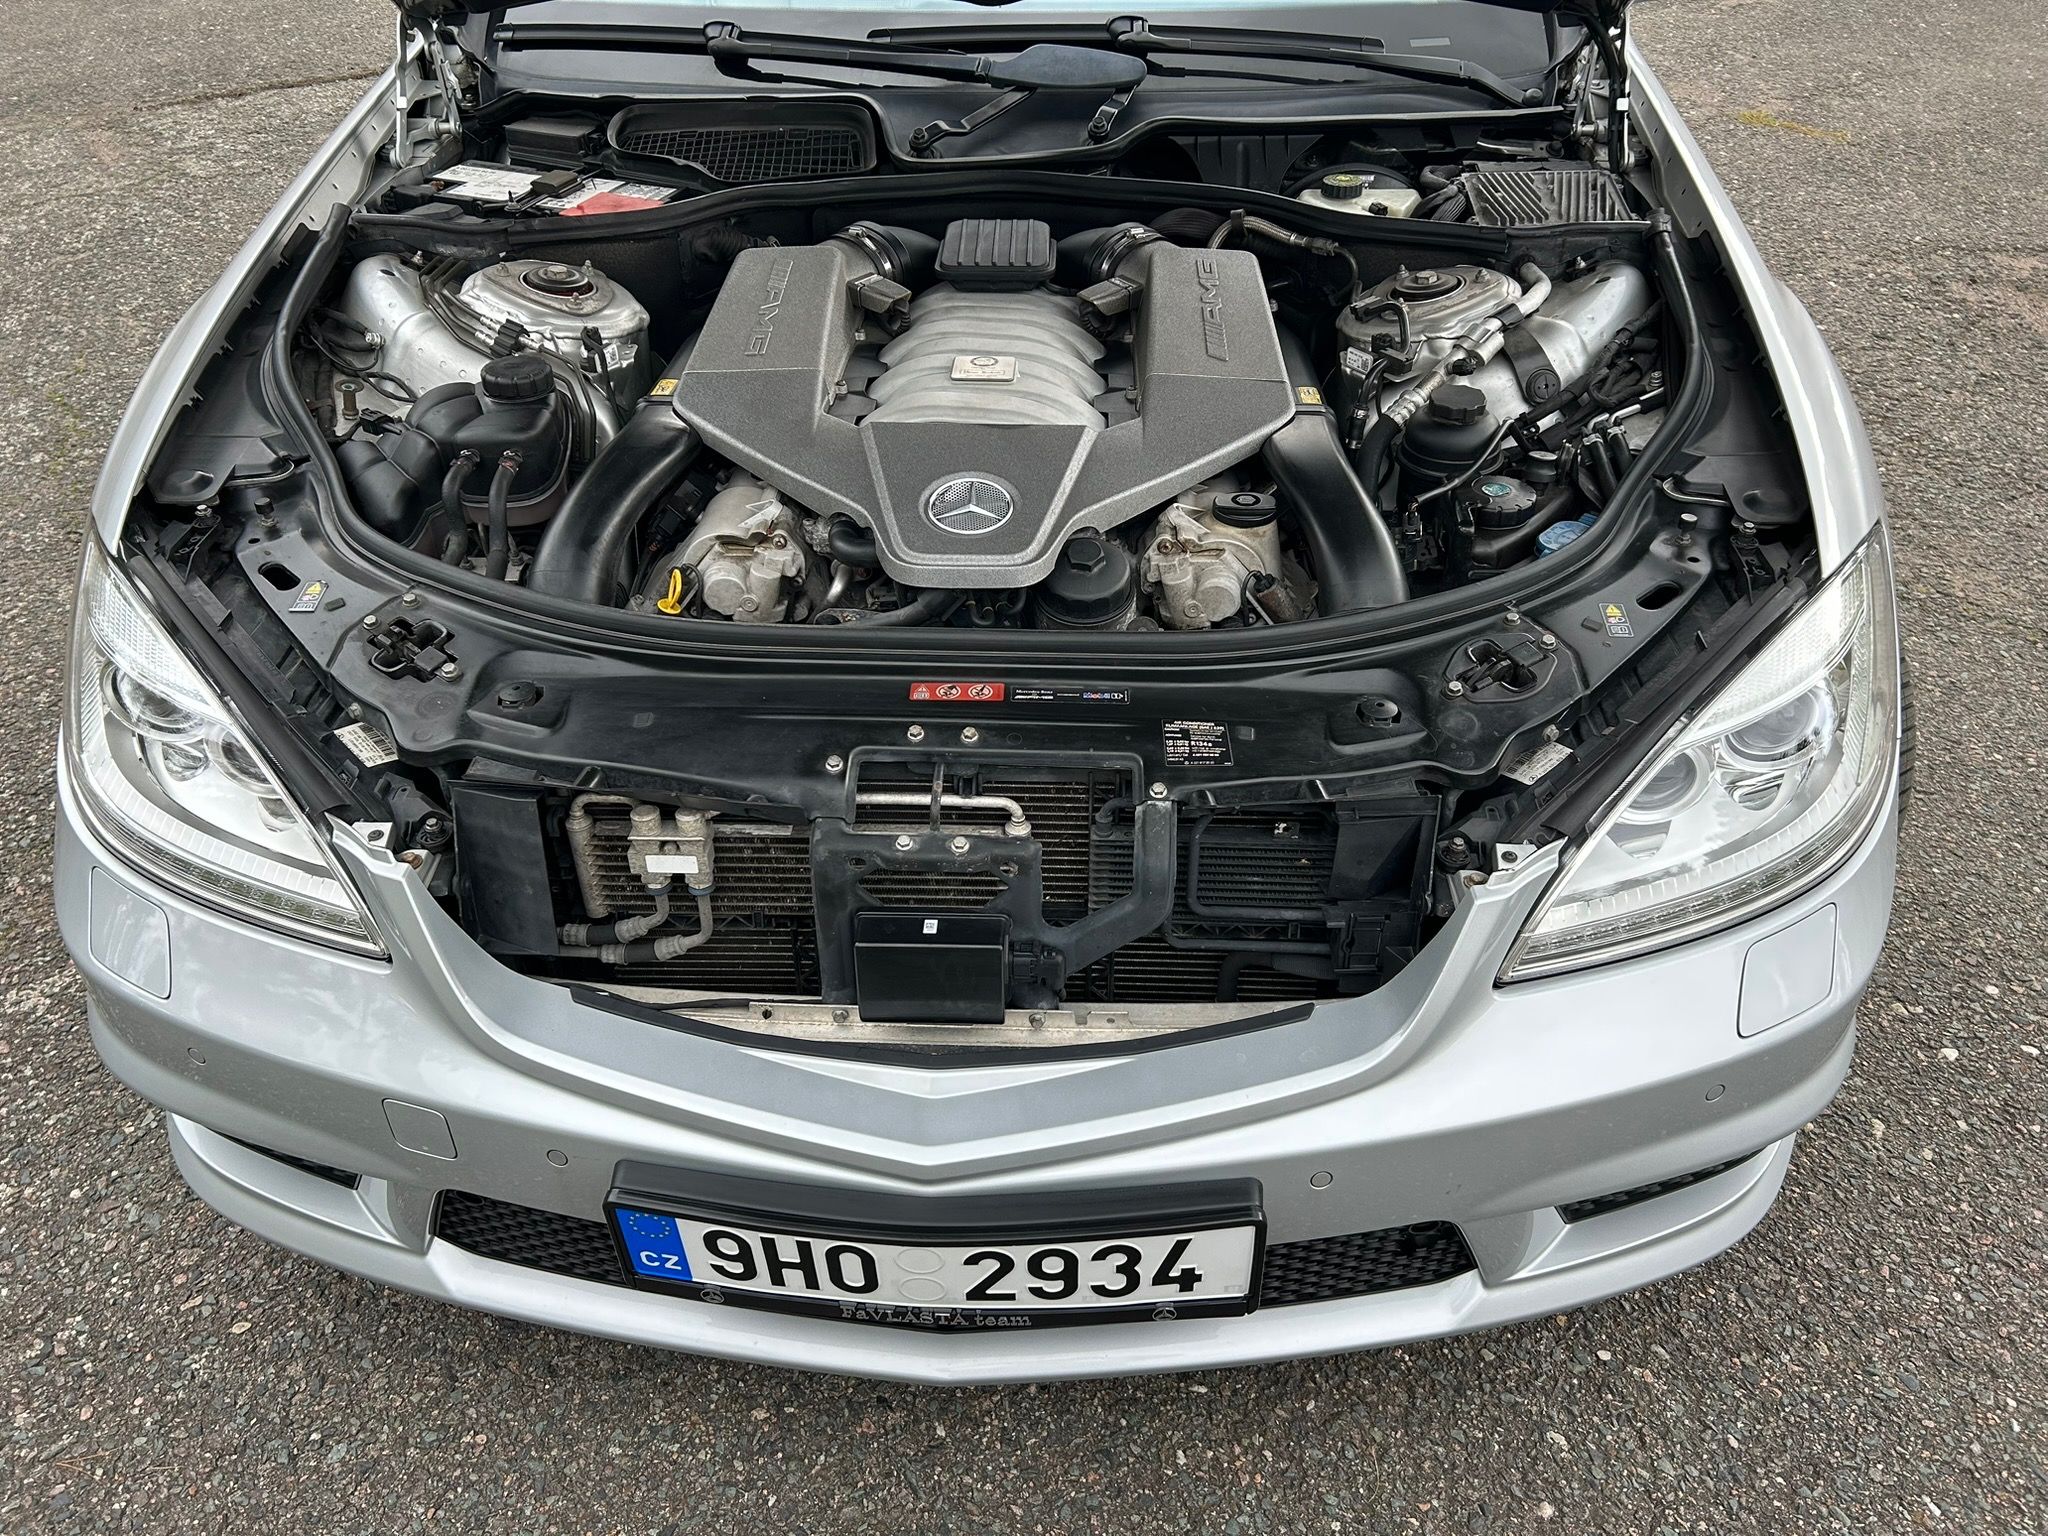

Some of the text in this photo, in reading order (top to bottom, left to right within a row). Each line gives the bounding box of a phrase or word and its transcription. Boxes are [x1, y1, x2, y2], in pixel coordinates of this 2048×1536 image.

[639, 1251, 682, 1271] CZ
[702, 1229, 1203, 1301] 9H0 2934
[974, 1310, 1032, 1327] team
